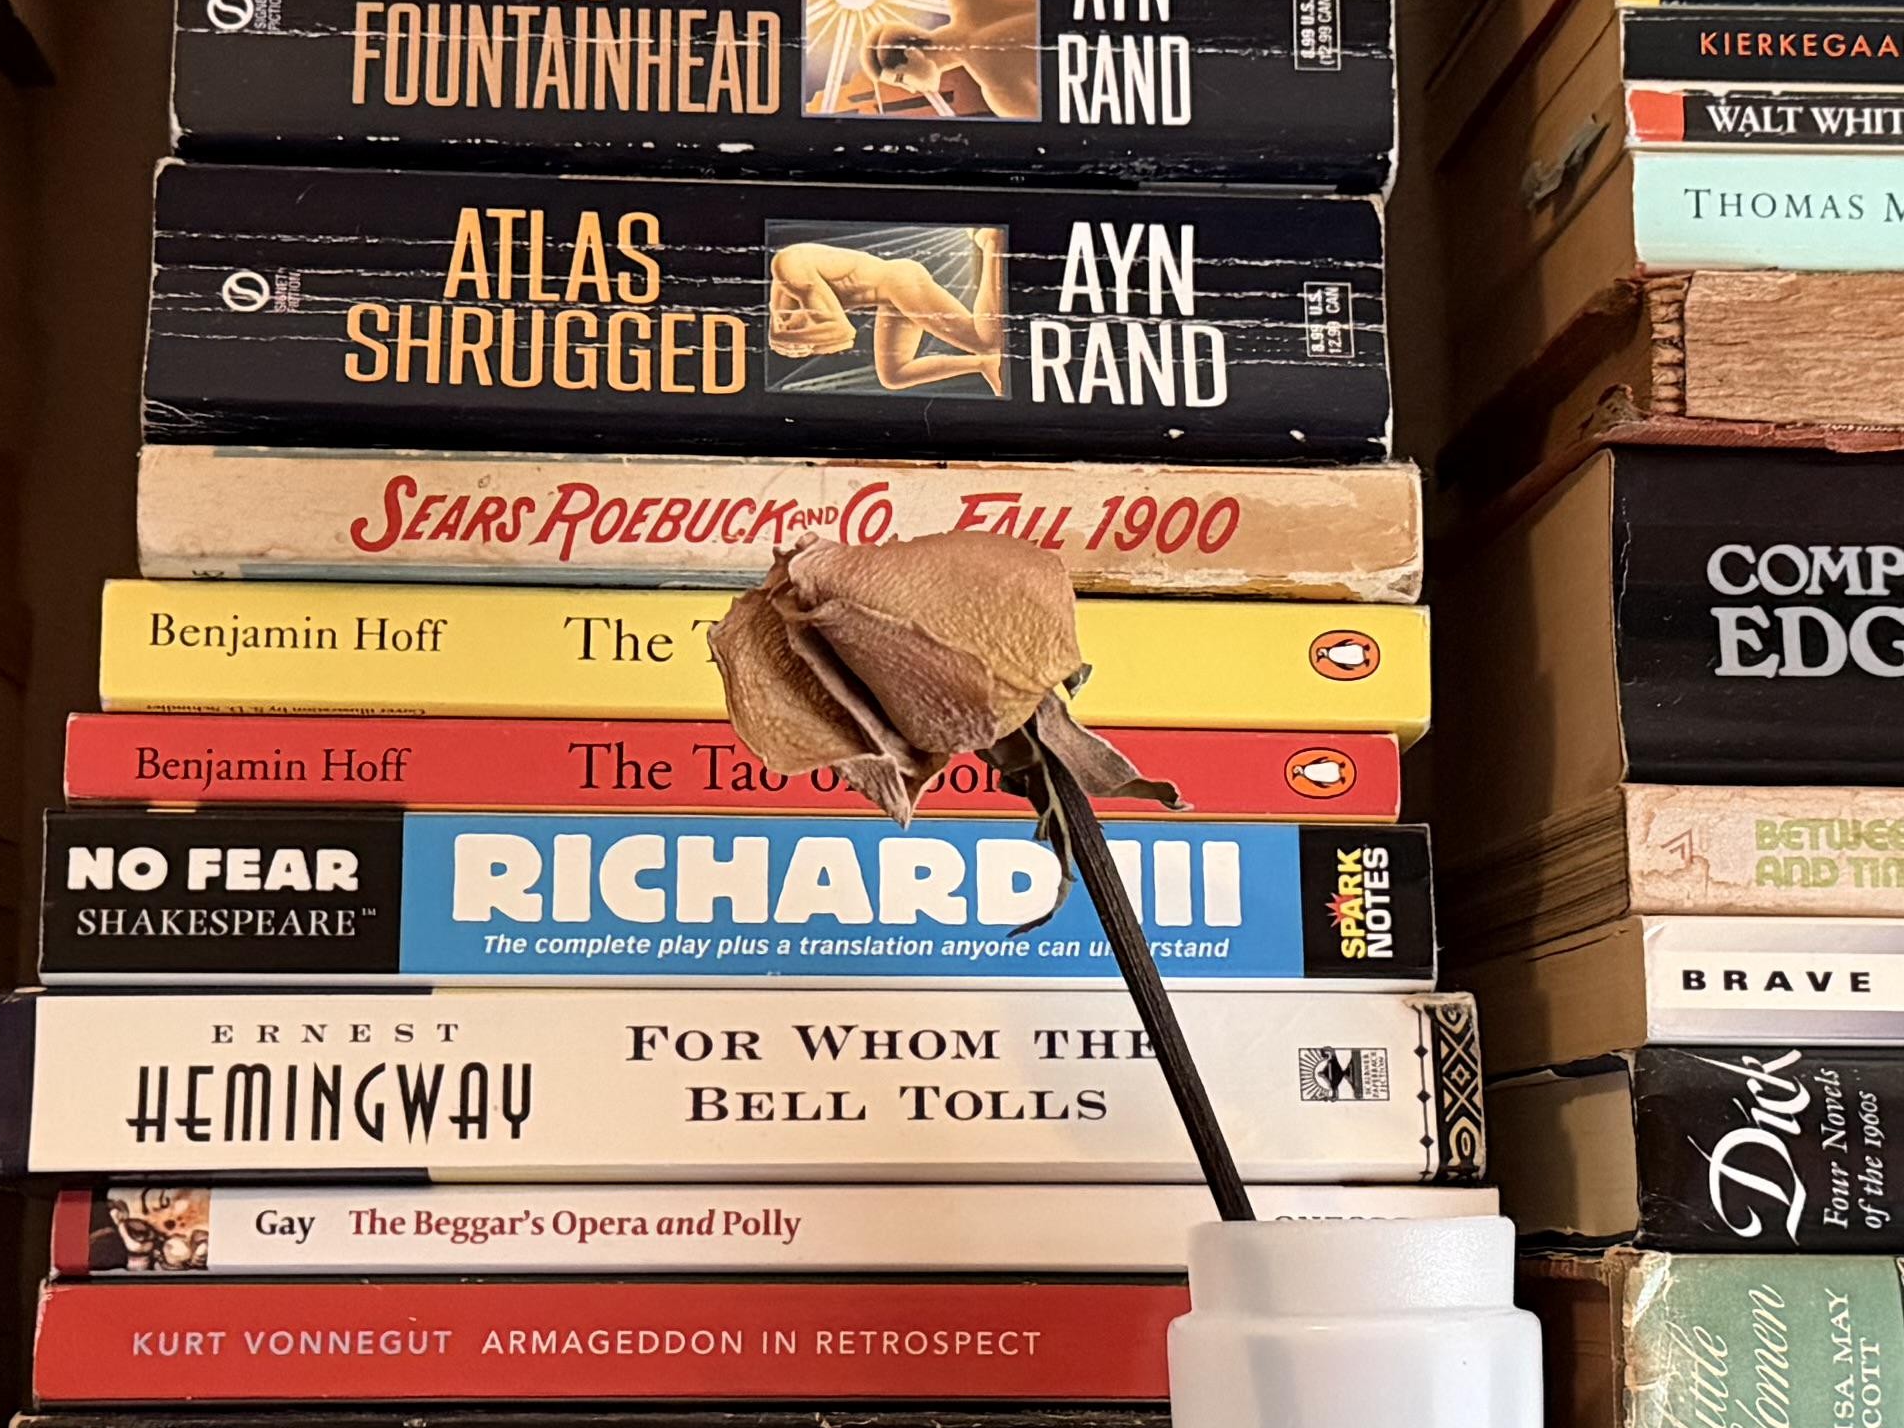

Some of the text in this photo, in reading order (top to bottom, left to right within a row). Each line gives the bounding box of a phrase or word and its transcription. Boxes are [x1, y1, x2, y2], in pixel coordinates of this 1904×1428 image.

[1684, 188, 1866, 222] THOMAS
[149, 612, 448, 657] Benjamin Hoff
[484, 934, 528, 954] The
[535, 934, 652, 961] complete
[658, 934, 712, 959] play
[716, 935, 771, 962] plus
[776, 940, 791, 957] a
[799, 935, 934, 957] translation
[941, 939, 1031, 962] anyone
[1038, 938, 1081, 958] can
[1338, 846, 1364, 960] SPARK
[1365, 846, 1394, 959] NOTES
[1821, 1067, 1850, 1230] Four Novels
[1861, 1091, 1887, 1230] of the 1960s
